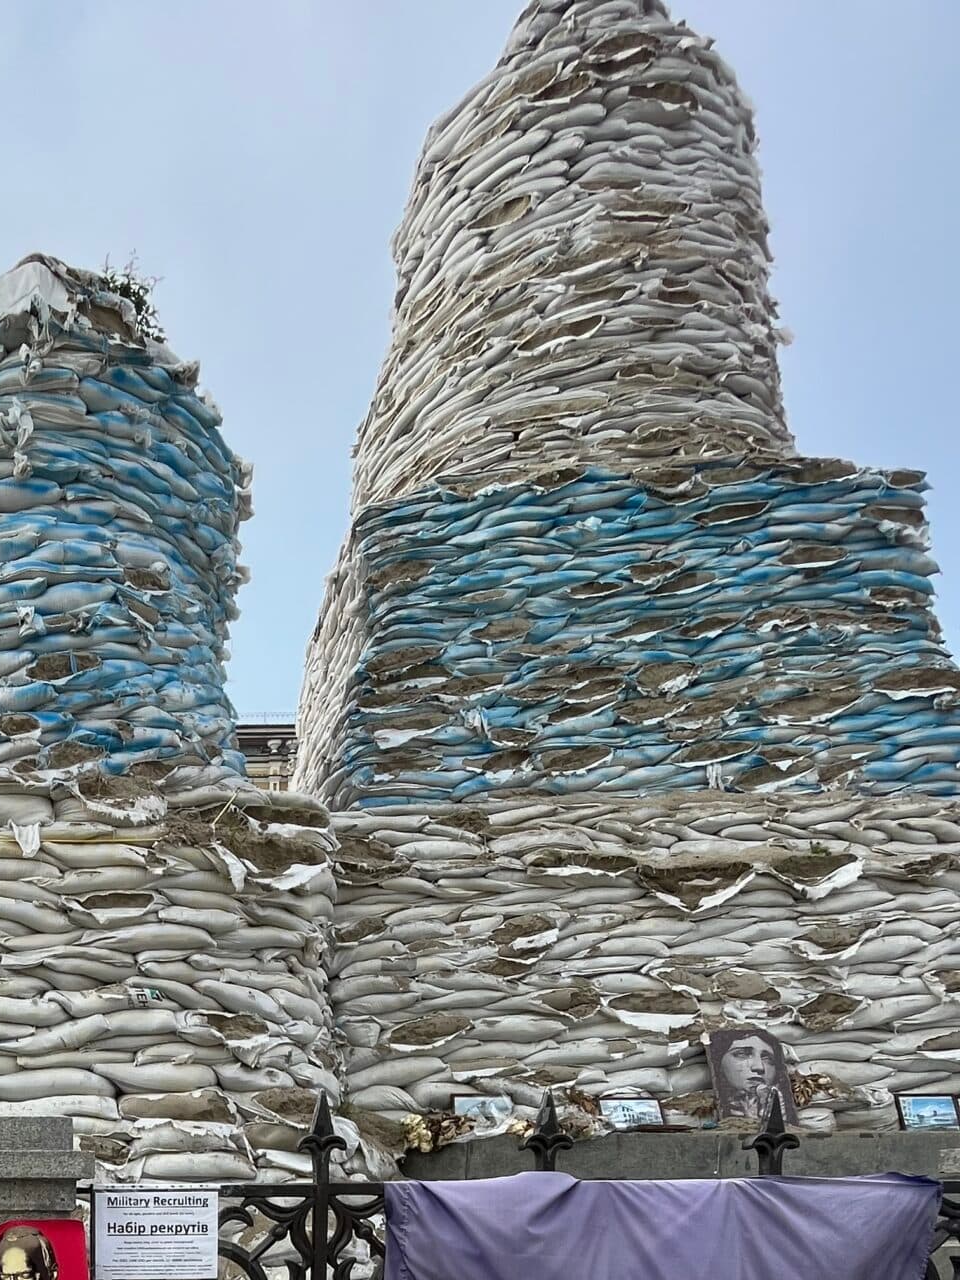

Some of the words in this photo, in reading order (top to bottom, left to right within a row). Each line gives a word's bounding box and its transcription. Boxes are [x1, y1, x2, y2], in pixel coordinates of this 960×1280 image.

[107, 1196, 150, 1208] Military
[153, 1196, 209, 1208] Recruiting
[107, 1221, 146, 1236] Набір
[150, 1221, 209, 1236] рекрутів
